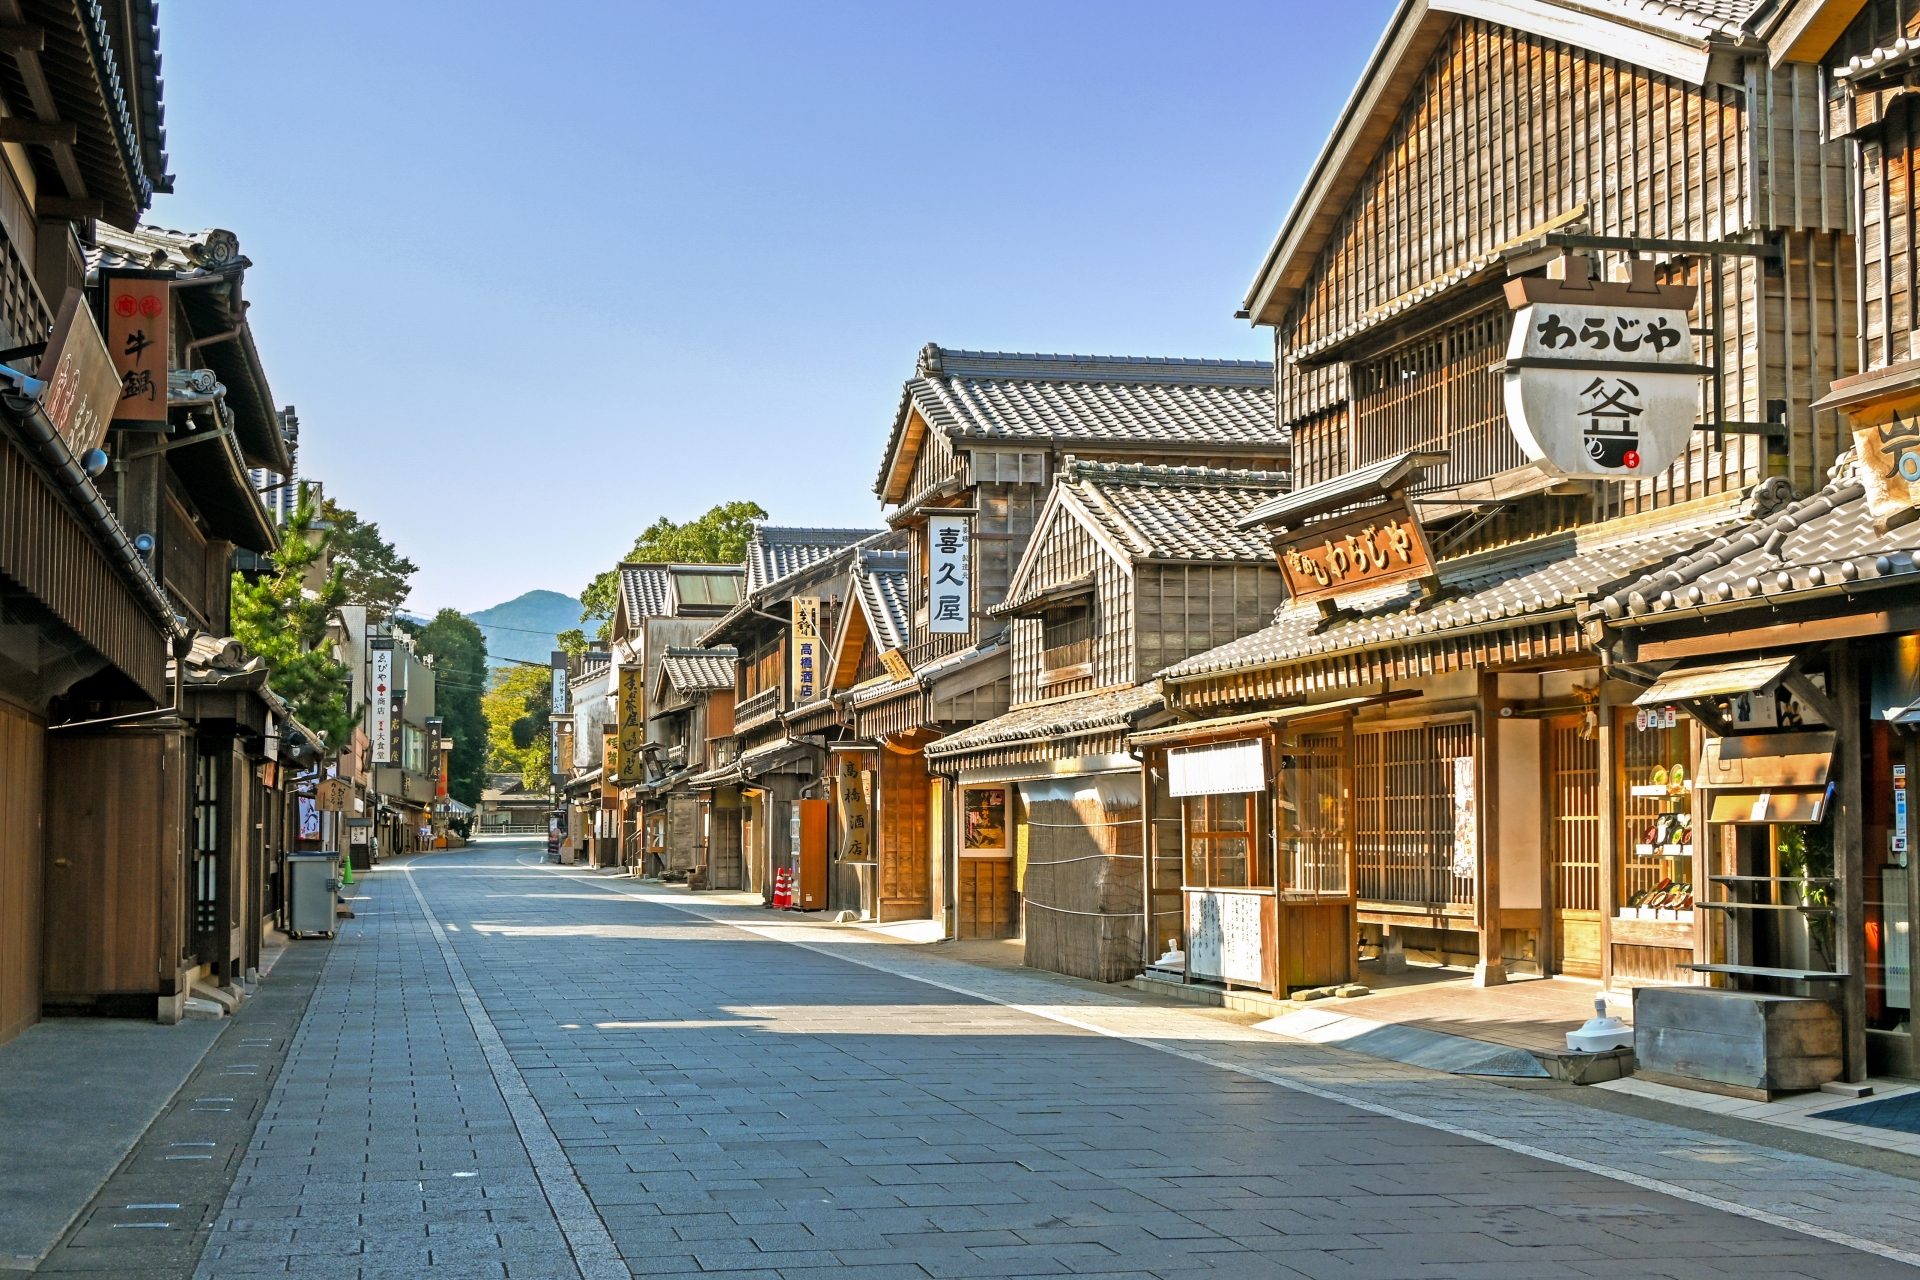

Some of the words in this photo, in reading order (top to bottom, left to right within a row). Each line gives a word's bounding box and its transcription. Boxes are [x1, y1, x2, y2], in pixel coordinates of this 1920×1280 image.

[1537, 314, 1681, 353] わらじや
[122, 329, 157, 402] 牛鍋
[934, 526, 964, 622] 喜久屋
[377, 652, 388, 682] ゑびや
[801, 643, 813, 697] 高橋酒店
[376, 697, 386, 715] 商店
[376, 733, 386, 760] 大食堂
